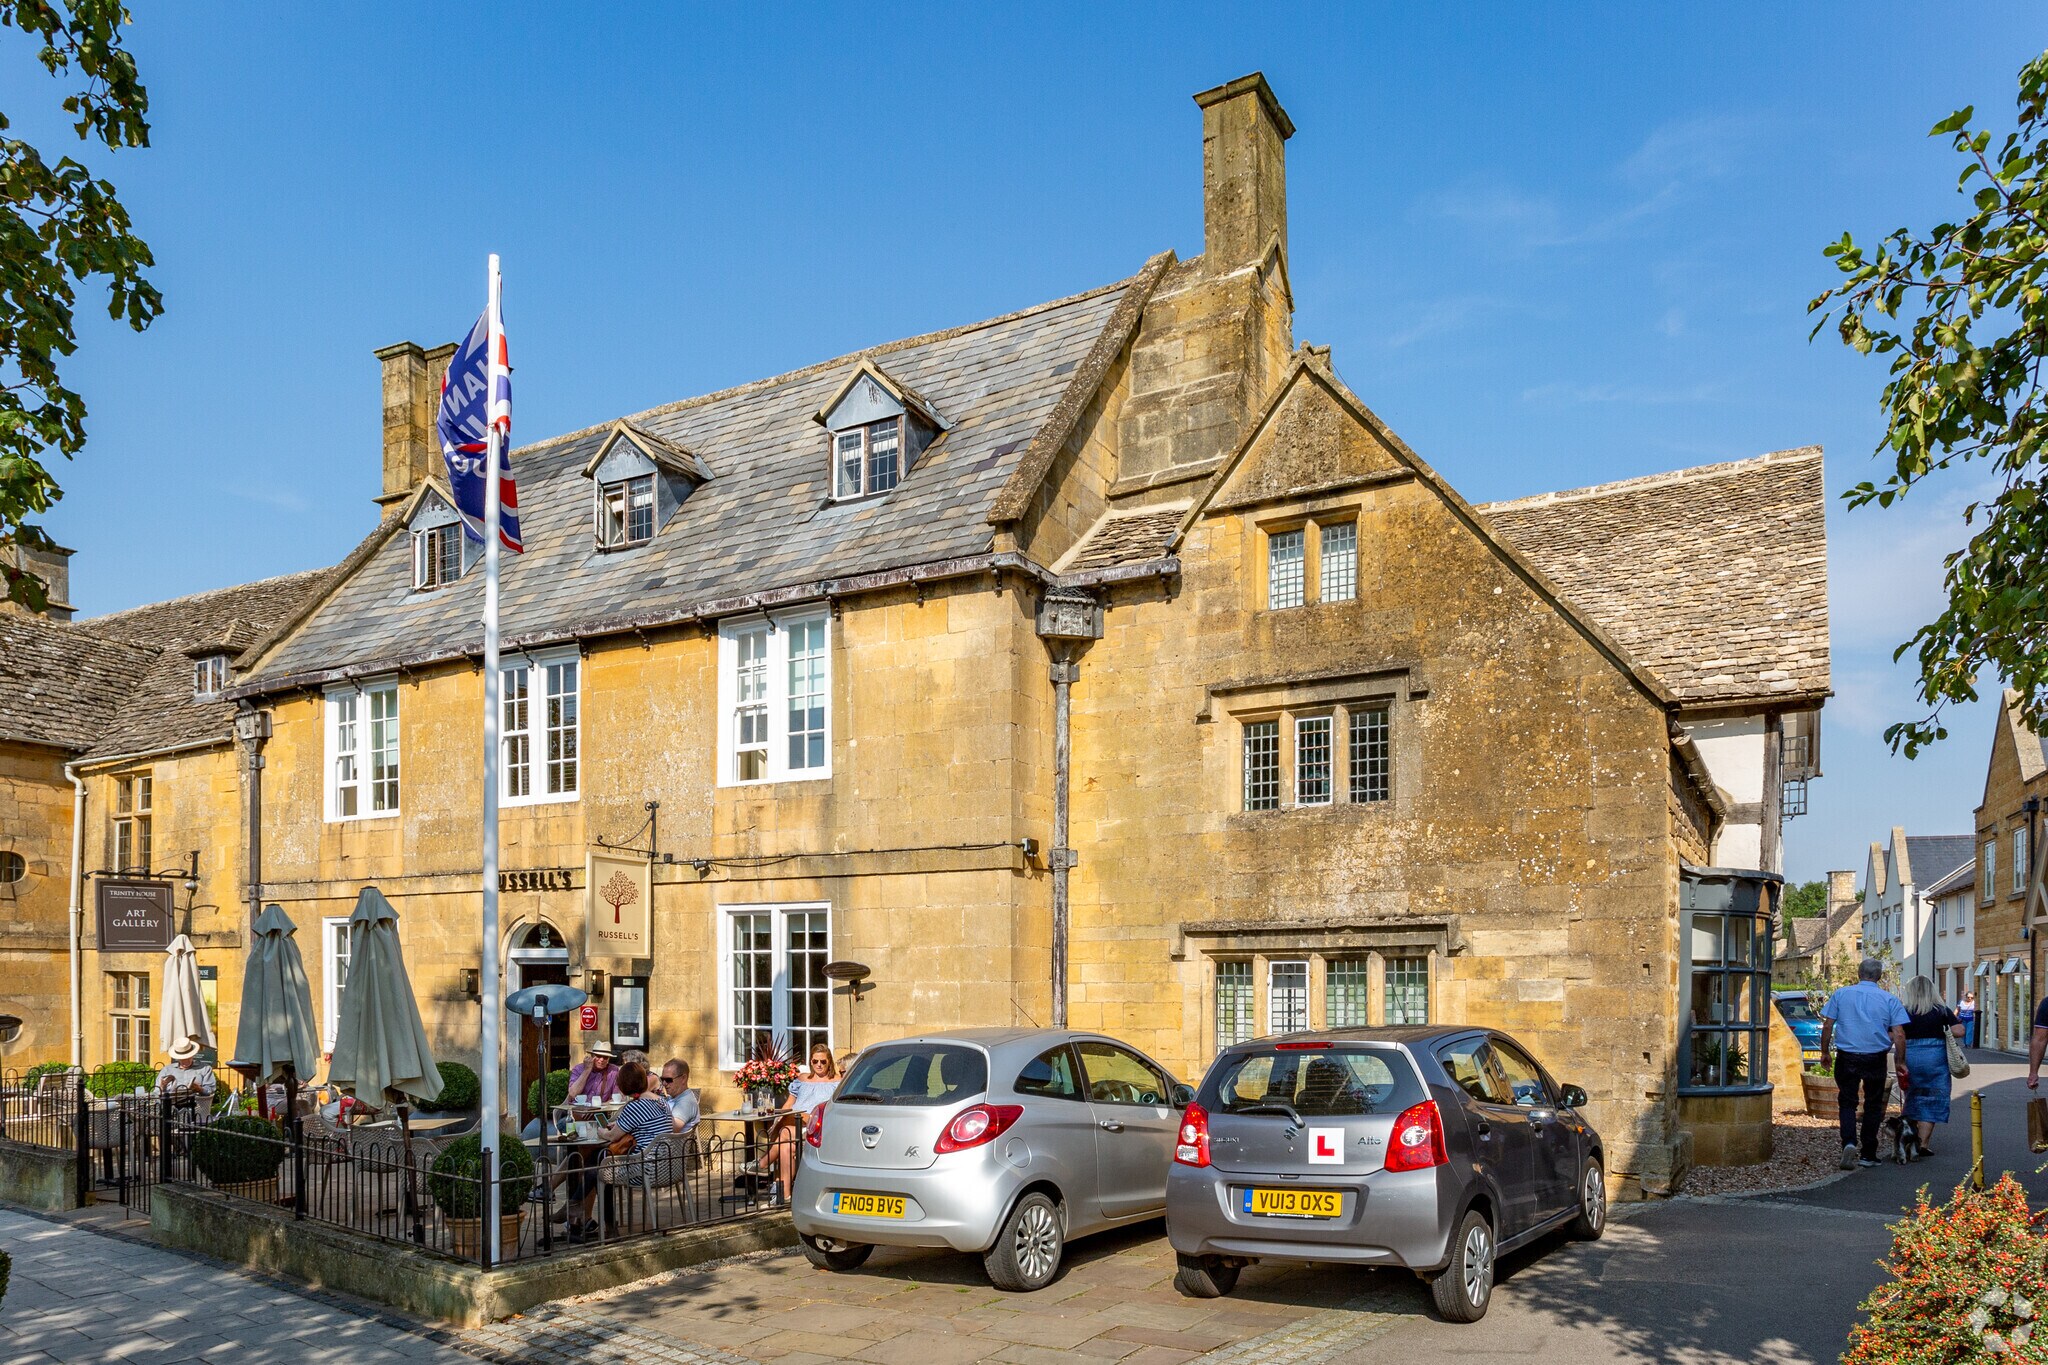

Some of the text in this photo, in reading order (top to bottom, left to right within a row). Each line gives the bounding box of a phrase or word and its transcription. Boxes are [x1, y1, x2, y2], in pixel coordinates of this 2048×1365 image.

[499, 871, 571, 892] USSELL'S
[126, 909, 147, 917] ART
[112, 918, 160, 928] GALLERY
[598, 930, 639, 941] RUSSELL'S
[1317, 1135, 1335, 1156] L
[1357, 1136, 1383, 1146] Alto
[841, 1195, 904, 1215] FN09 BVS
[1259, 1192, 1335, 1212] VU13 OXS
